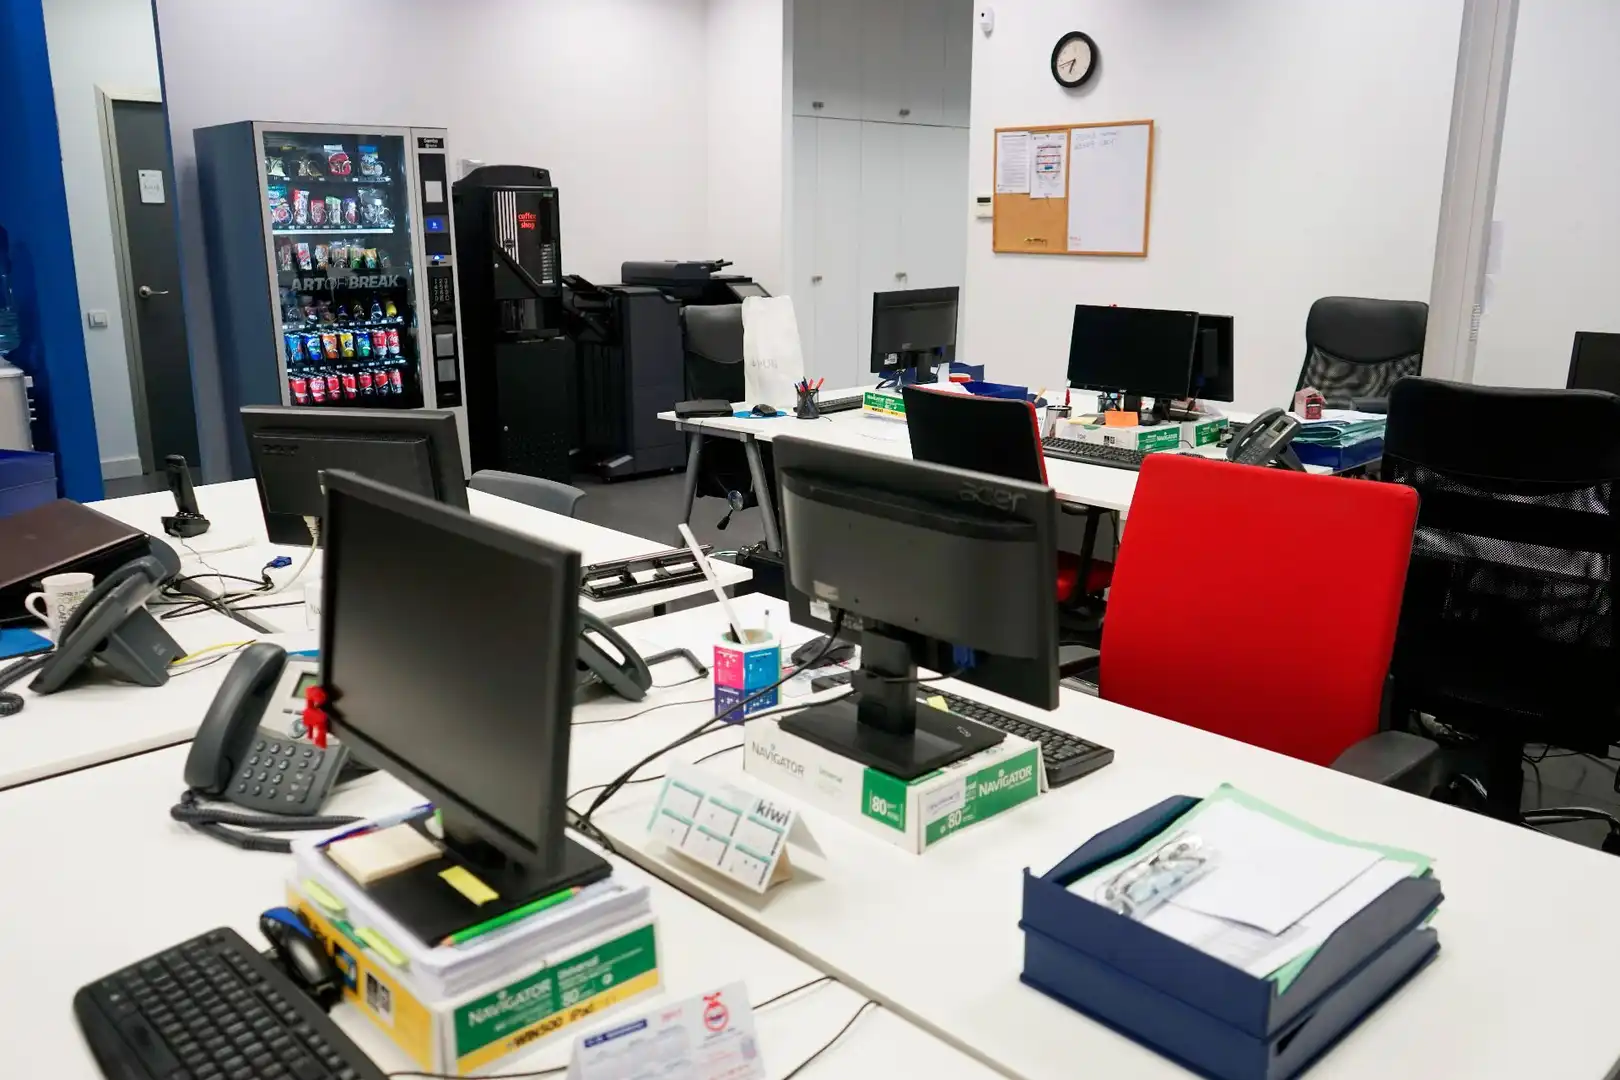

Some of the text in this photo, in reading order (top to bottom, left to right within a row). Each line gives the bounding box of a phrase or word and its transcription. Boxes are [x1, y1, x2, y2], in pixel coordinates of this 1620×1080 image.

[520, 221, 536, 230] shop
[291, 276, 325, 291] ART
[348, 274, 399, 290] BREAK
[959, 480, 1027, 512] acer
[752, 741, 805, 778] NAVIGATOR
[978, 763, 1033, 797] NAVIGATOR
[755, 799, 791, 826] kiwi
[871, 795, 887, 815] 80
[947, 810, 963, 829] 80
[468, 978, 553, 1027] NAVIGATOR
